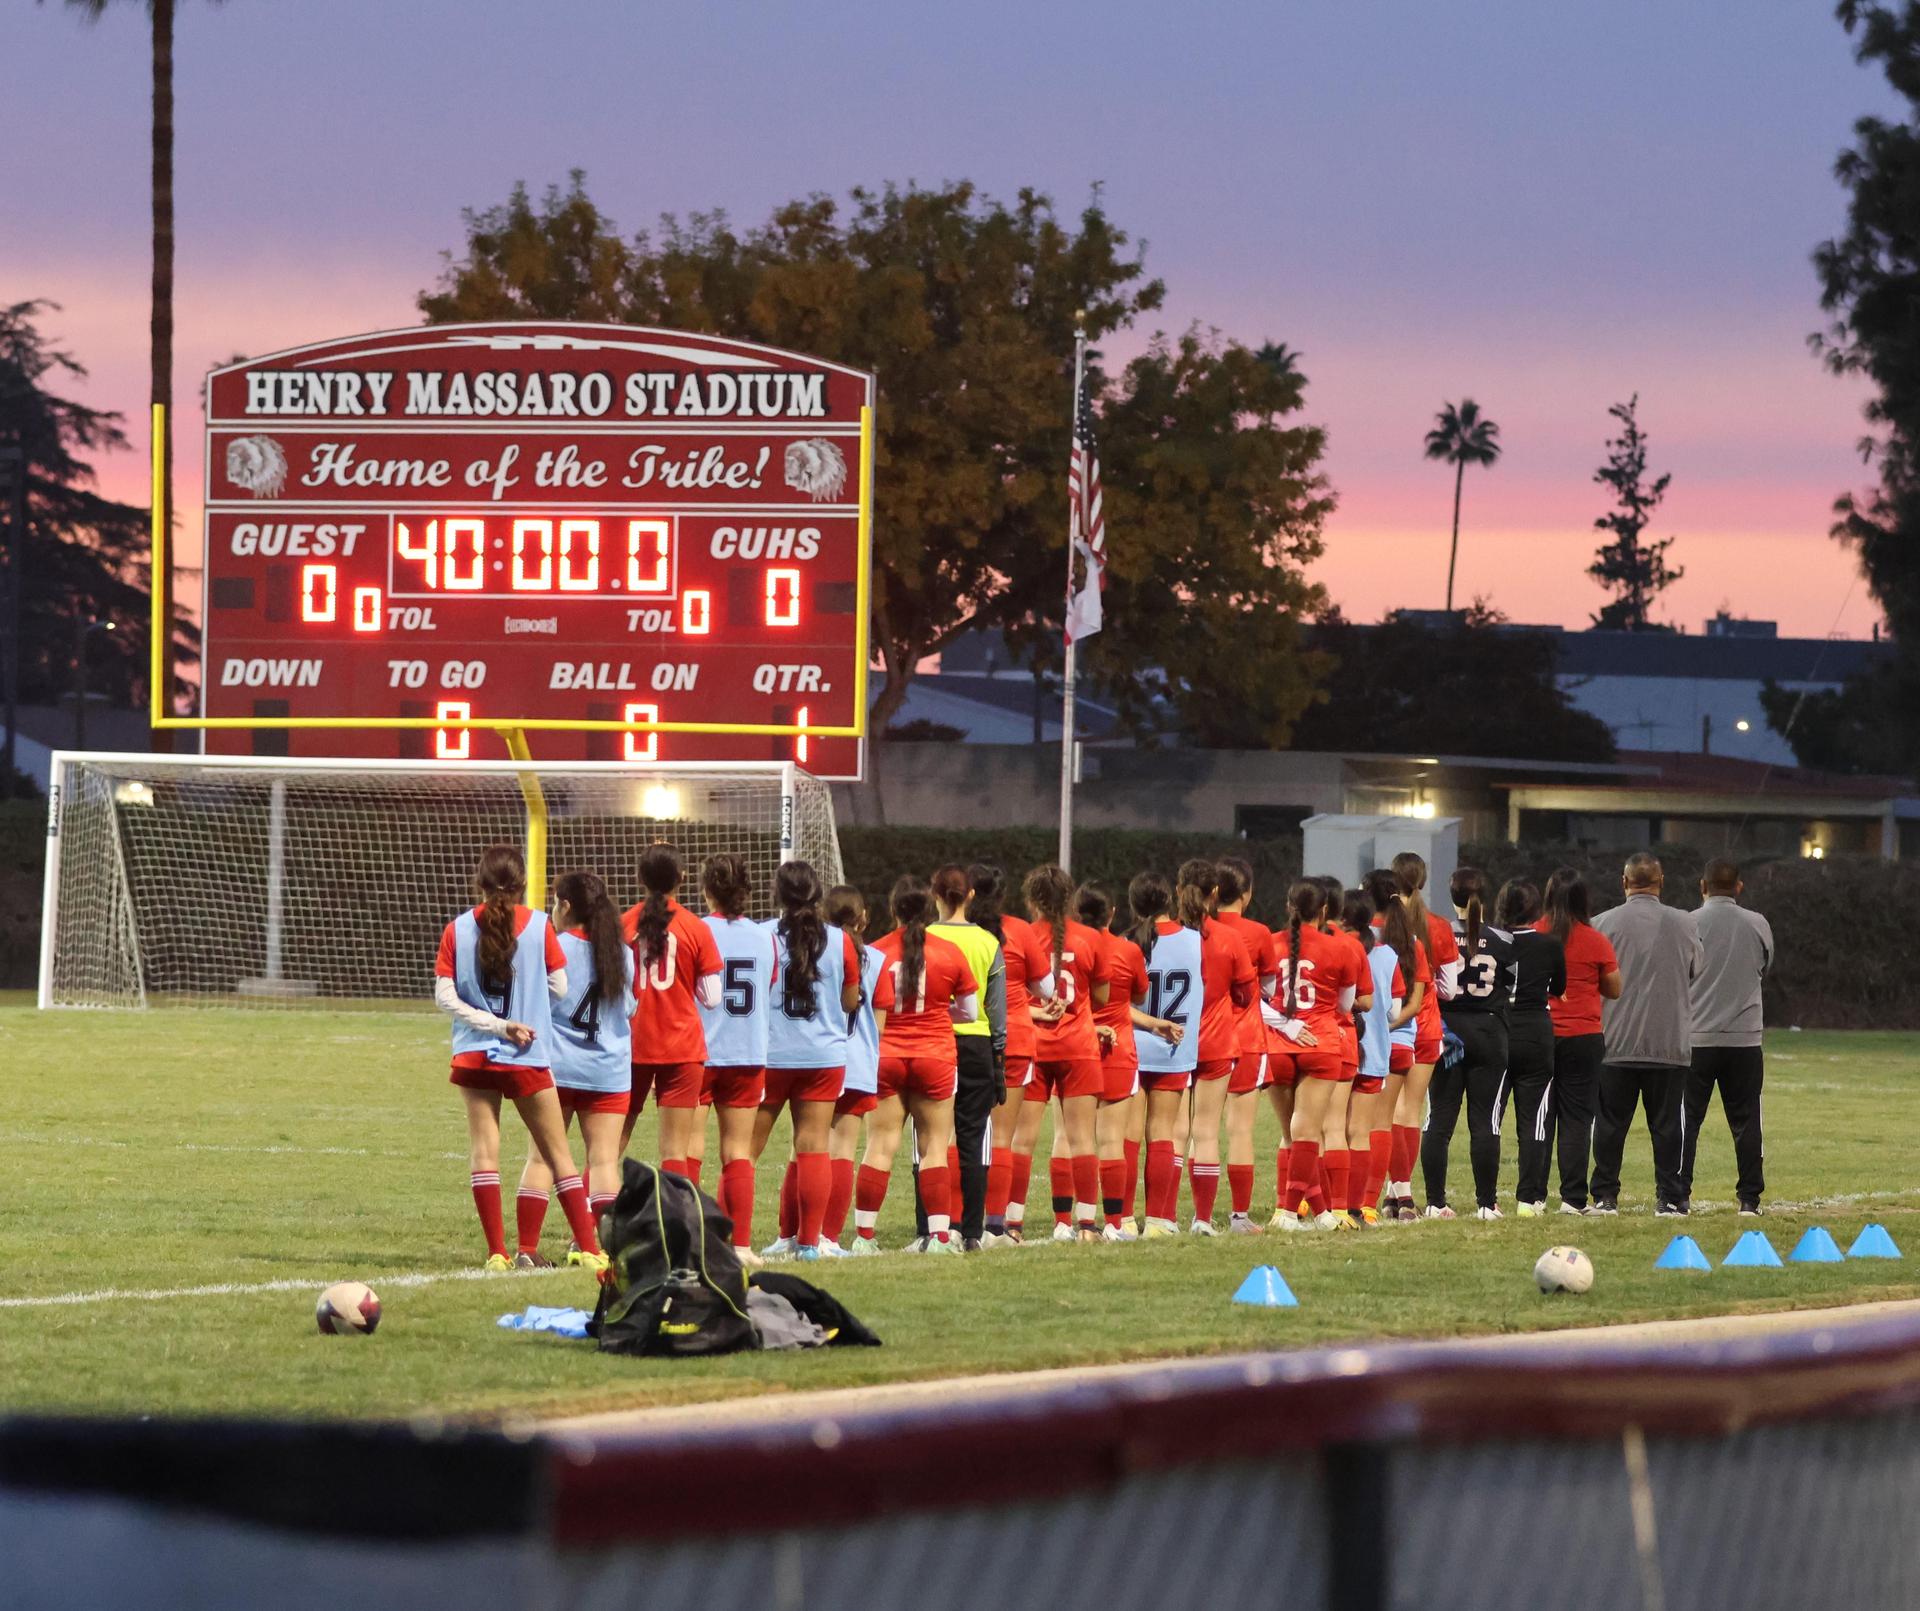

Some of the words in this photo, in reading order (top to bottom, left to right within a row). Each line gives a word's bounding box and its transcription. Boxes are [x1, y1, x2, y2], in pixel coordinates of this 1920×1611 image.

[245, 371, 393, 415] HENRY
[404, 372, 611, 416] MASSARO
[624, 373, 826, 417] STADIUM
[301, 443, 452, 487] Home
[464, 444, 520, 501] of
[534, 444, 608, 488] the
[621, 444, 771, 489] Tribe!
[231, 523, 366, 556] GUEST
[709, 527, 822, 560] CUHS
[302, 564, 337, 622] 0
[353, 587, 381, 632] 0
[682, 590, 710, 634] 0
[765, 568, 800, 626] 0
[387, 607, 437, 630] TOL
[627, 609, 677, 632] TOL
[220, 658, 323, 687] DOWN
[387, 660, 429, 688] TO
[439, 660, 487, 689] GO
[549, 662, 636, 690] BALL
[650, 663, 699, 692] ON
[752, 664, 832, 695] QTR.
[436, 701, 471, 759] 0
[624, 703, 659, 761] 0
[632, 931, 677, 991] 10
[1278, 958, 1316, 1010] 16
[723, 957, 756, 1018] 5
[888, 960, 927, 1014] 11
[1146, 969, 1192, 1026] 12
[569, 982, 602, 1042] 4
